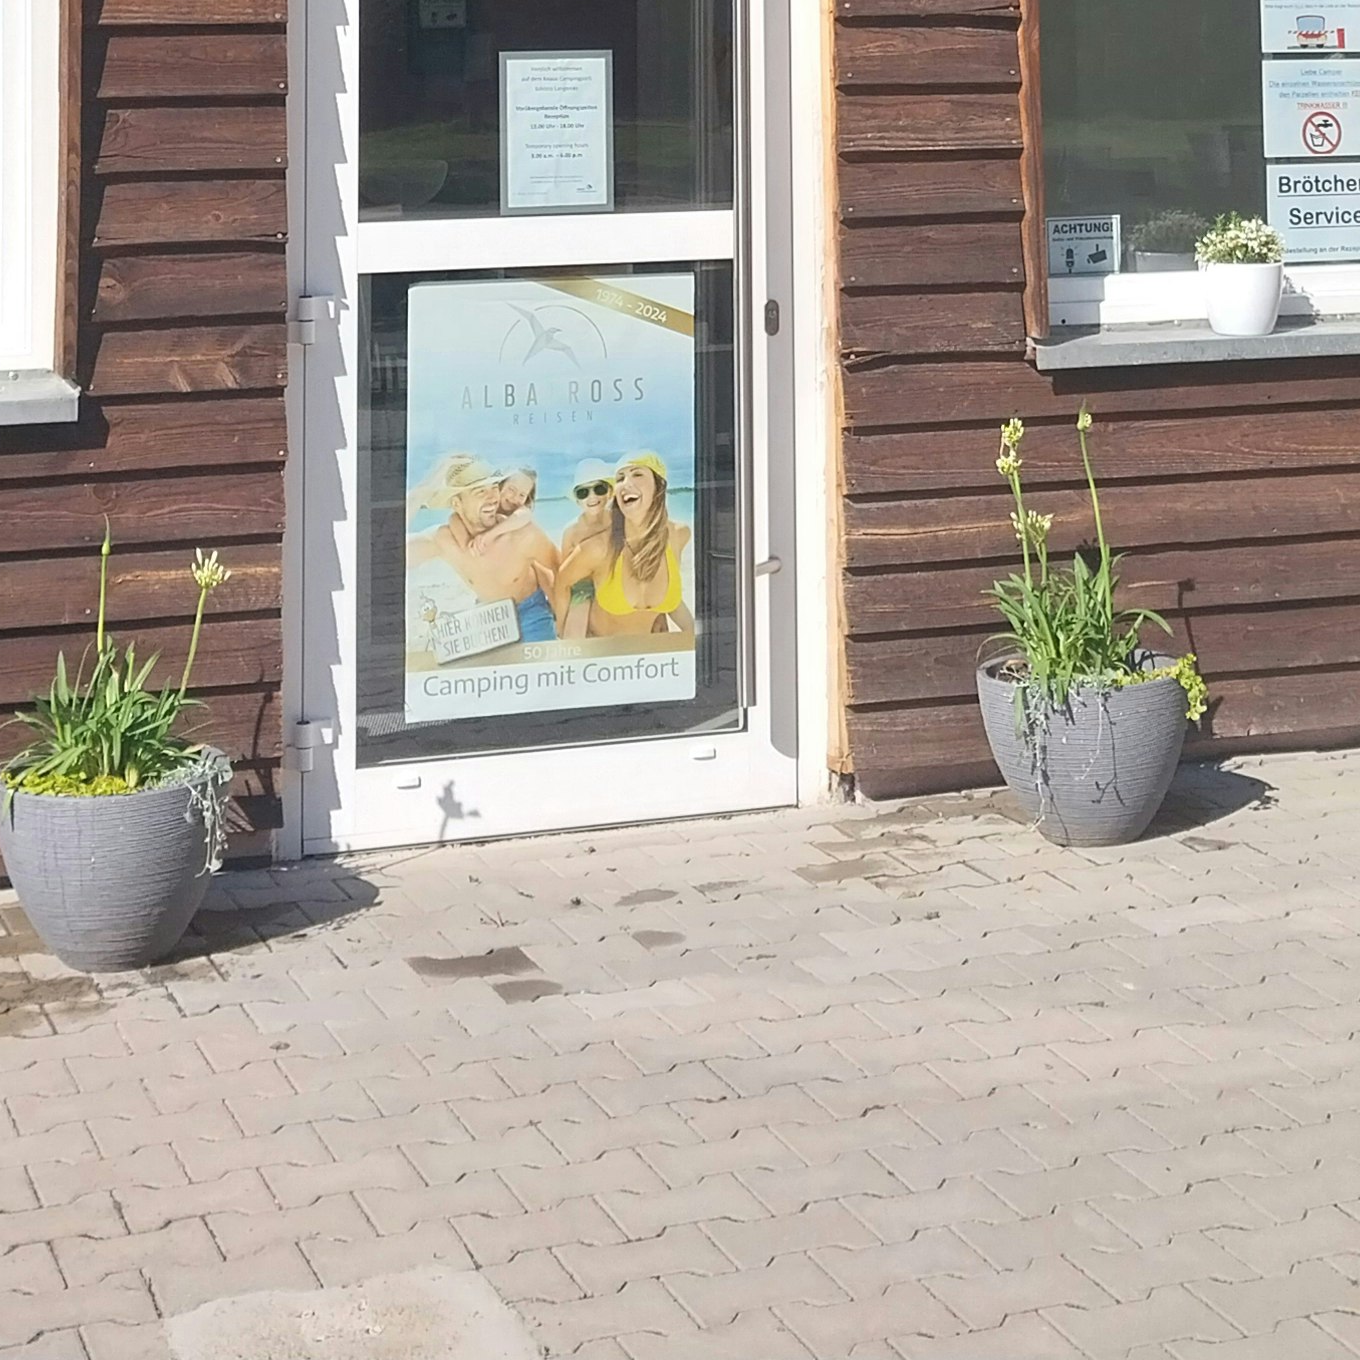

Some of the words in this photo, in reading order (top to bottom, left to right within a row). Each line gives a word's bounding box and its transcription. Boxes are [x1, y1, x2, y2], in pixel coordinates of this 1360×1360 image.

[1052, 222, 1113, 234] ACHTUNG!
[595, 288, 624, 307] 1974
[635, 302, 667, 323] 2024
[461, 377, 644, 409] ALBAROSS
[513, 410, 593, 425] REISEN
[464, 605, 509, 631] KNNEN
[443, 639, 461, 657] SIE
[524, 646, 542, 660] 50
[423, 671, 529, 697] Camping
[537, 665, 576, 687] mit
[582, 657, 679, 683] Comfort
